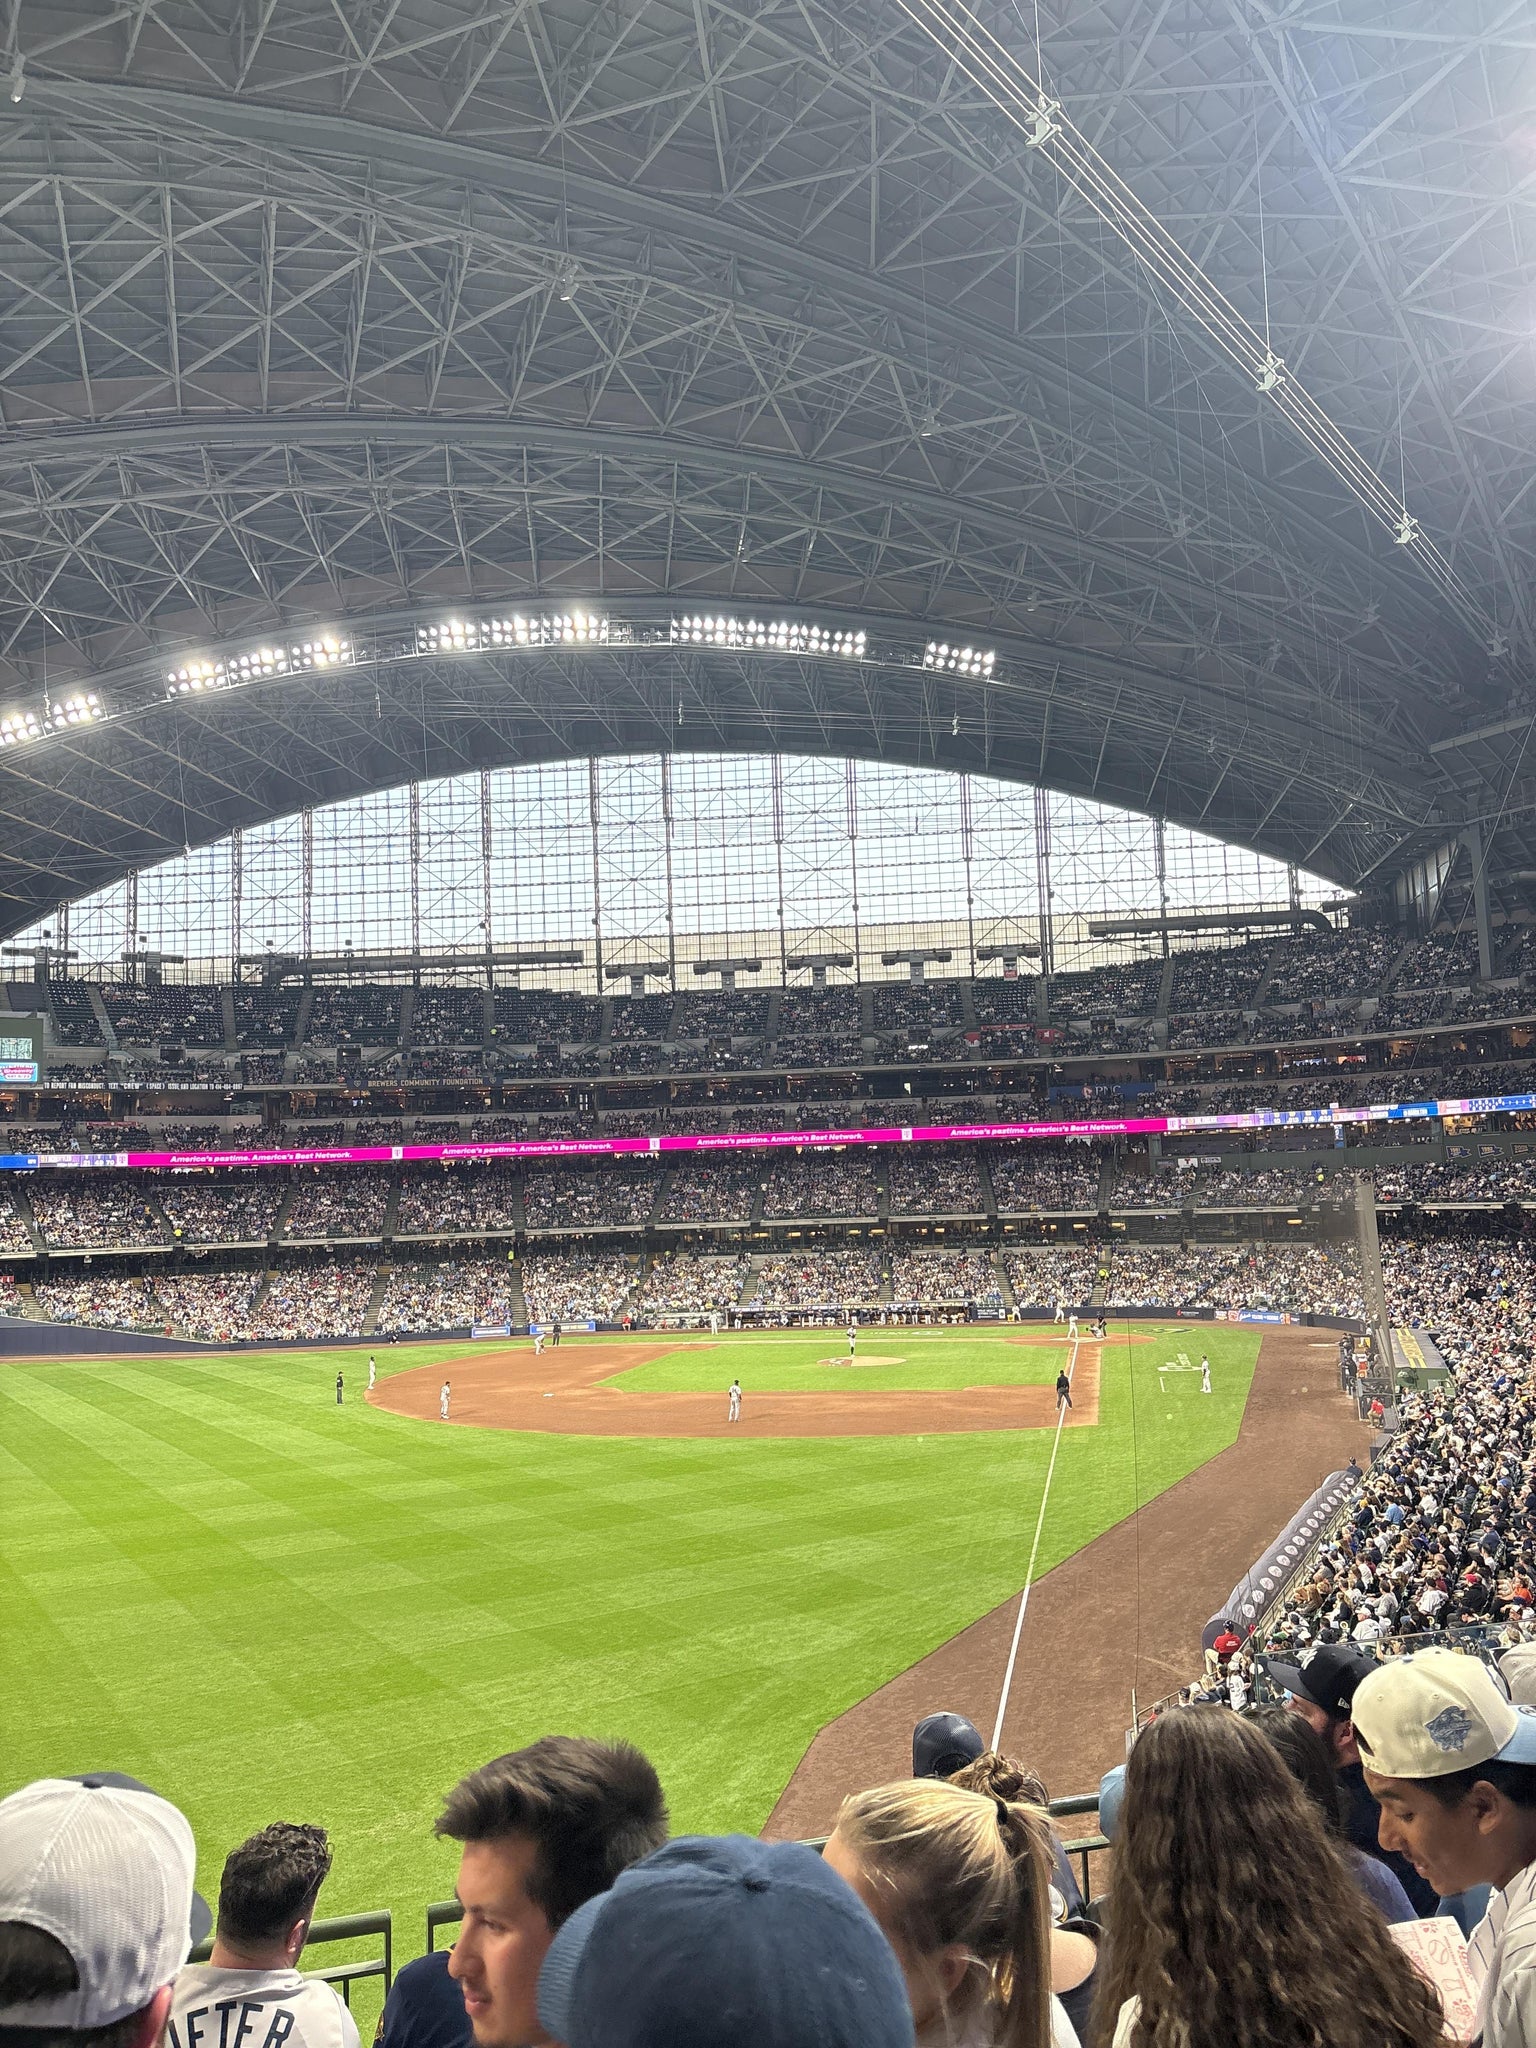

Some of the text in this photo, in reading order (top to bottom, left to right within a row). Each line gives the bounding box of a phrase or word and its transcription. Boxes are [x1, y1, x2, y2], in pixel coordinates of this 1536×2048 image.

[951, 1128, 991, 1136] America's
[991, 1128, 1026, 1136] pastime.
[1028, 1126, 1068, 1134] America's
[1089, 1123, 1127, 1131] Network.
[697, 1138, 735, 1146] America's
[736, 1137, 769, 1145] pastime.
[771, 1135, 810, 1143] America's
[170, 1151, 353, 1163] America's pastime. America's Best Network.
